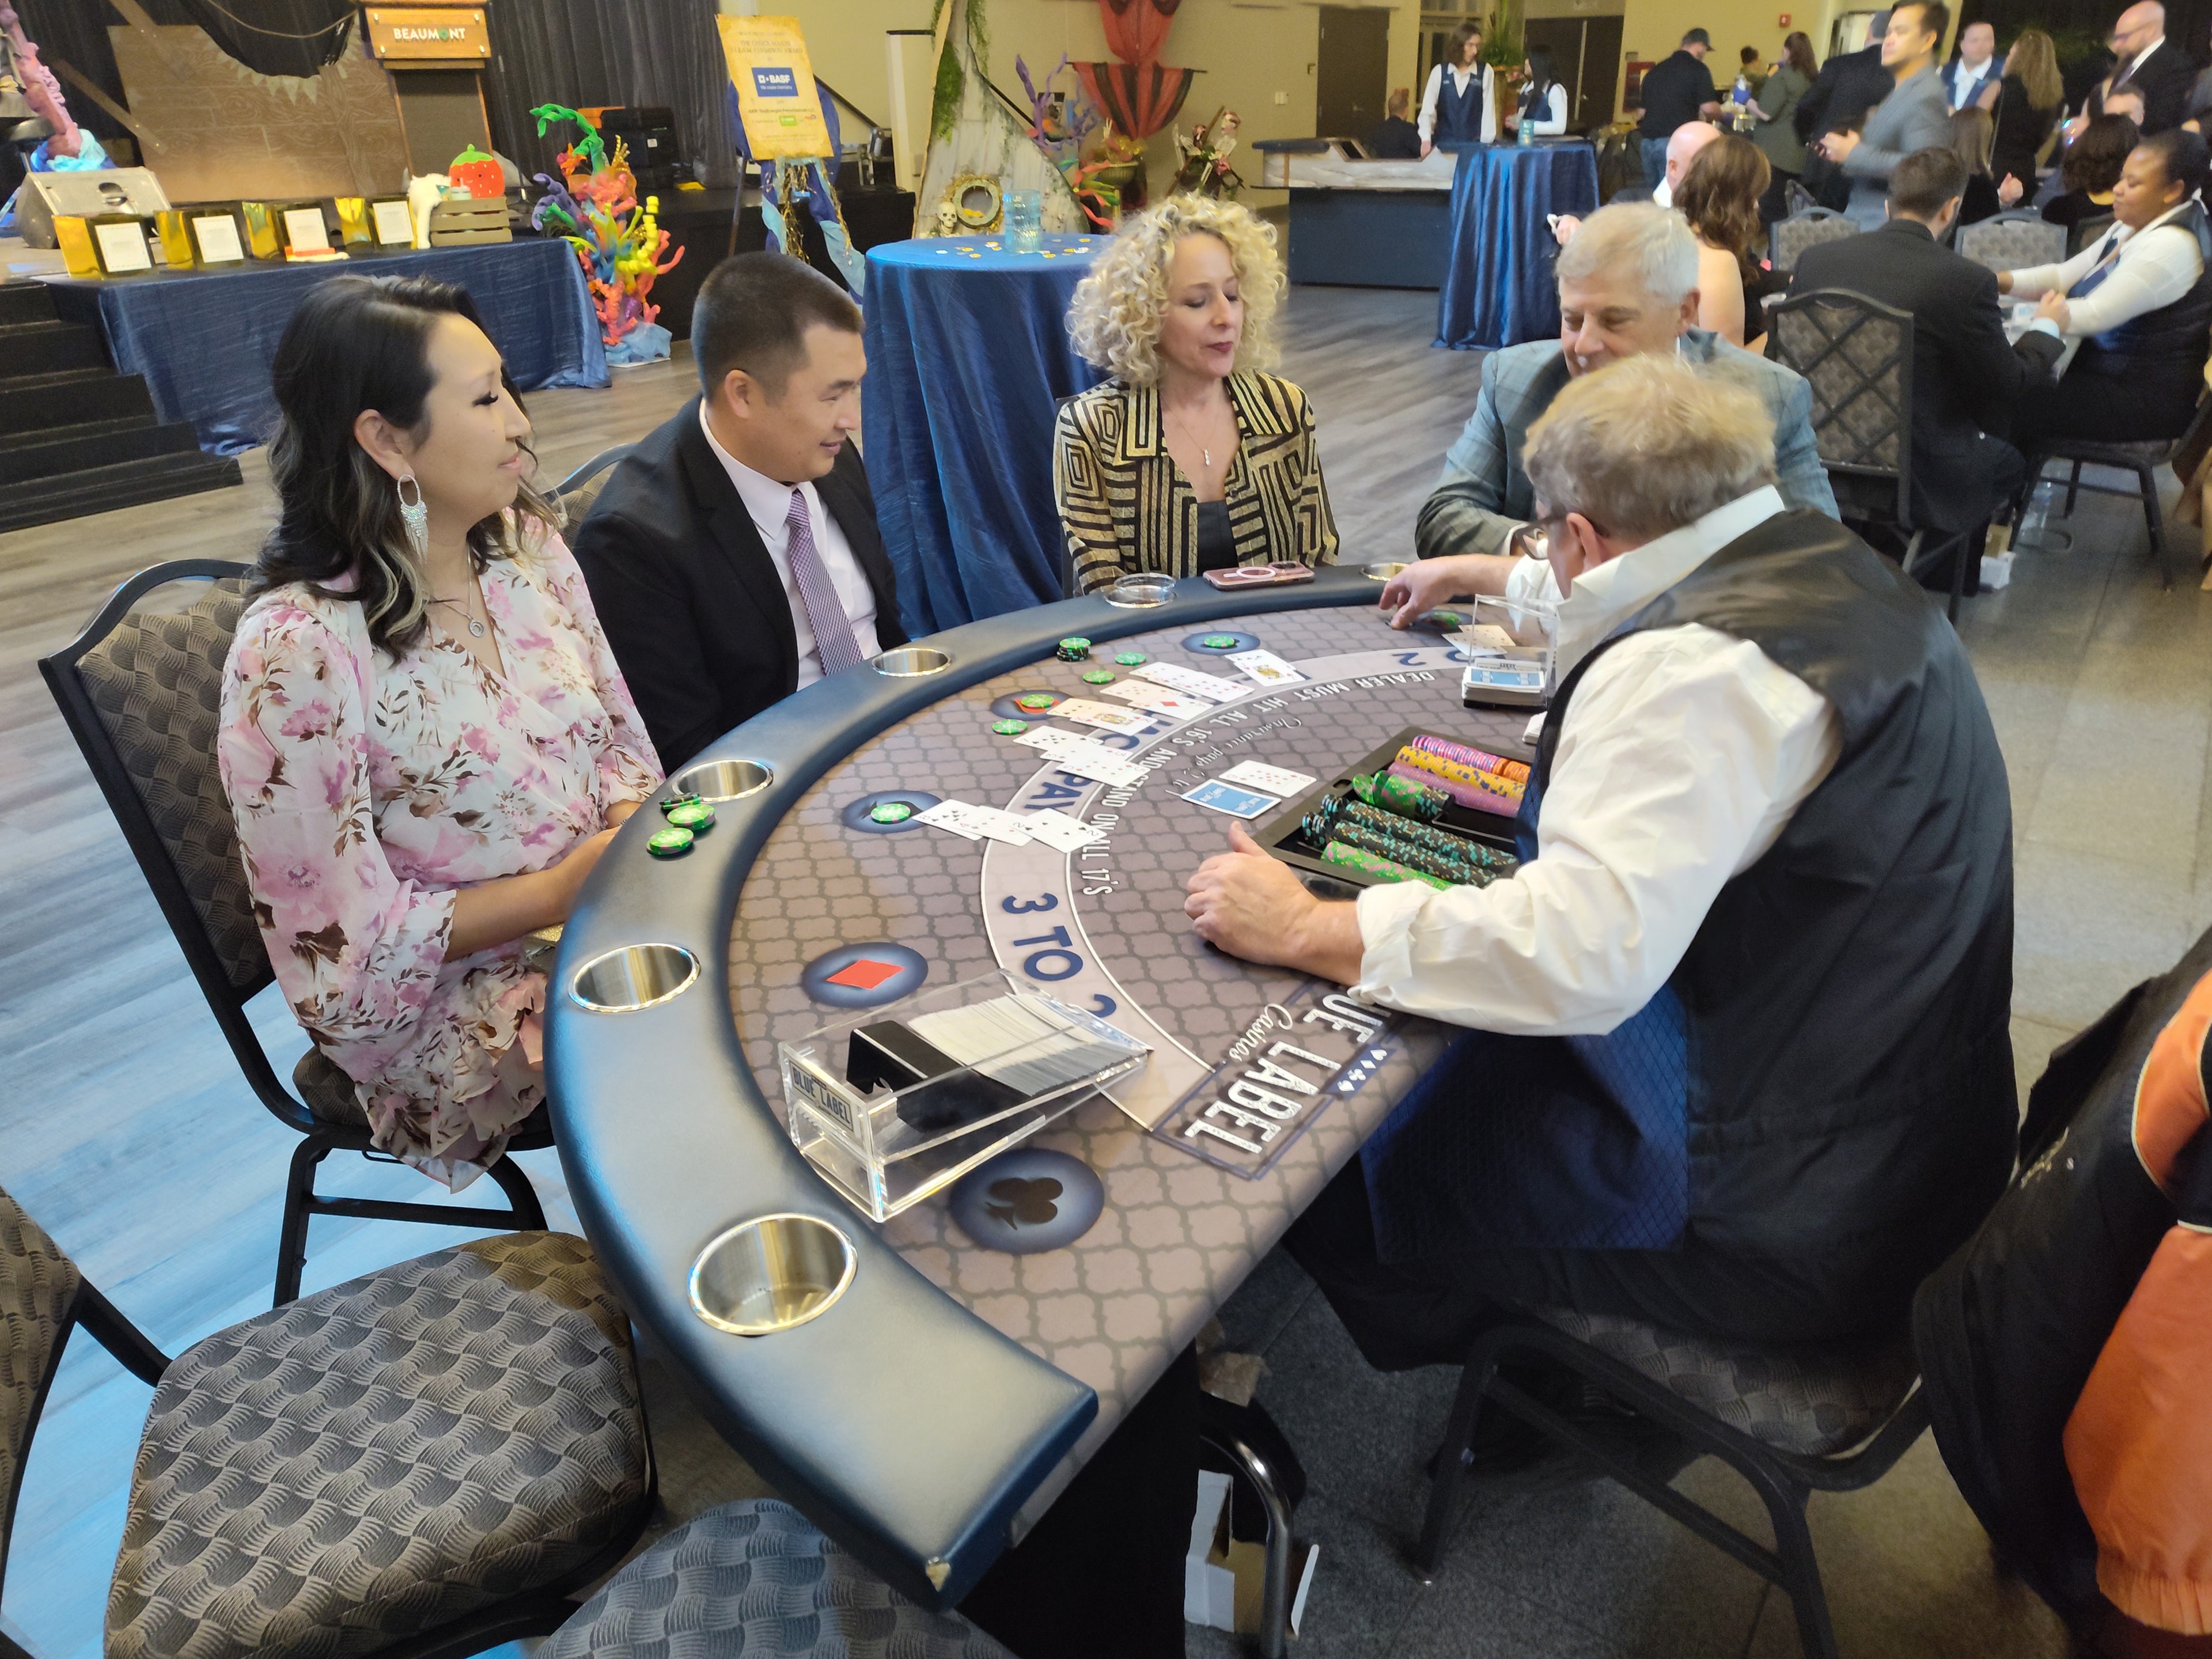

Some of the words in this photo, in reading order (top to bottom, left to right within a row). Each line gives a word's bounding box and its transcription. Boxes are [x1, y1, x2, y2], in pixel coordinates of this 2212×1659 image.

[393, 28, 465, 40] BEAUMONT
[769, 74, 790, 84] BASF
[1355, 671, 1436, 688] DEALER
[1293, 681, 1351, 701] MUST
[1252, 696, 1289, 713] HIT
[1209, 710, 1249, 727] ALL
[1172, 727, 1213, 747] 16'S
[1225, 717, 1302, 749] Insurance
[1138, 747, 1177, 770] AND
[1195, 745, 1224, 766] pays
[1090, 813, 1119, 831] ON
[1081, 868, 1120, 895] 17'S
[1002, 892, 1058, 914] 3
[1013, 925, 1084, 981] TO
[1302, 994, 1392, 1043] UE
[1229, 1003, 1293, 1062] Casinos
[793, 1066, 816, 1098] BLUE
[820, 1085, 851, 1124] LABEL
[1184, 1040, 1342, 1154] LABEL
